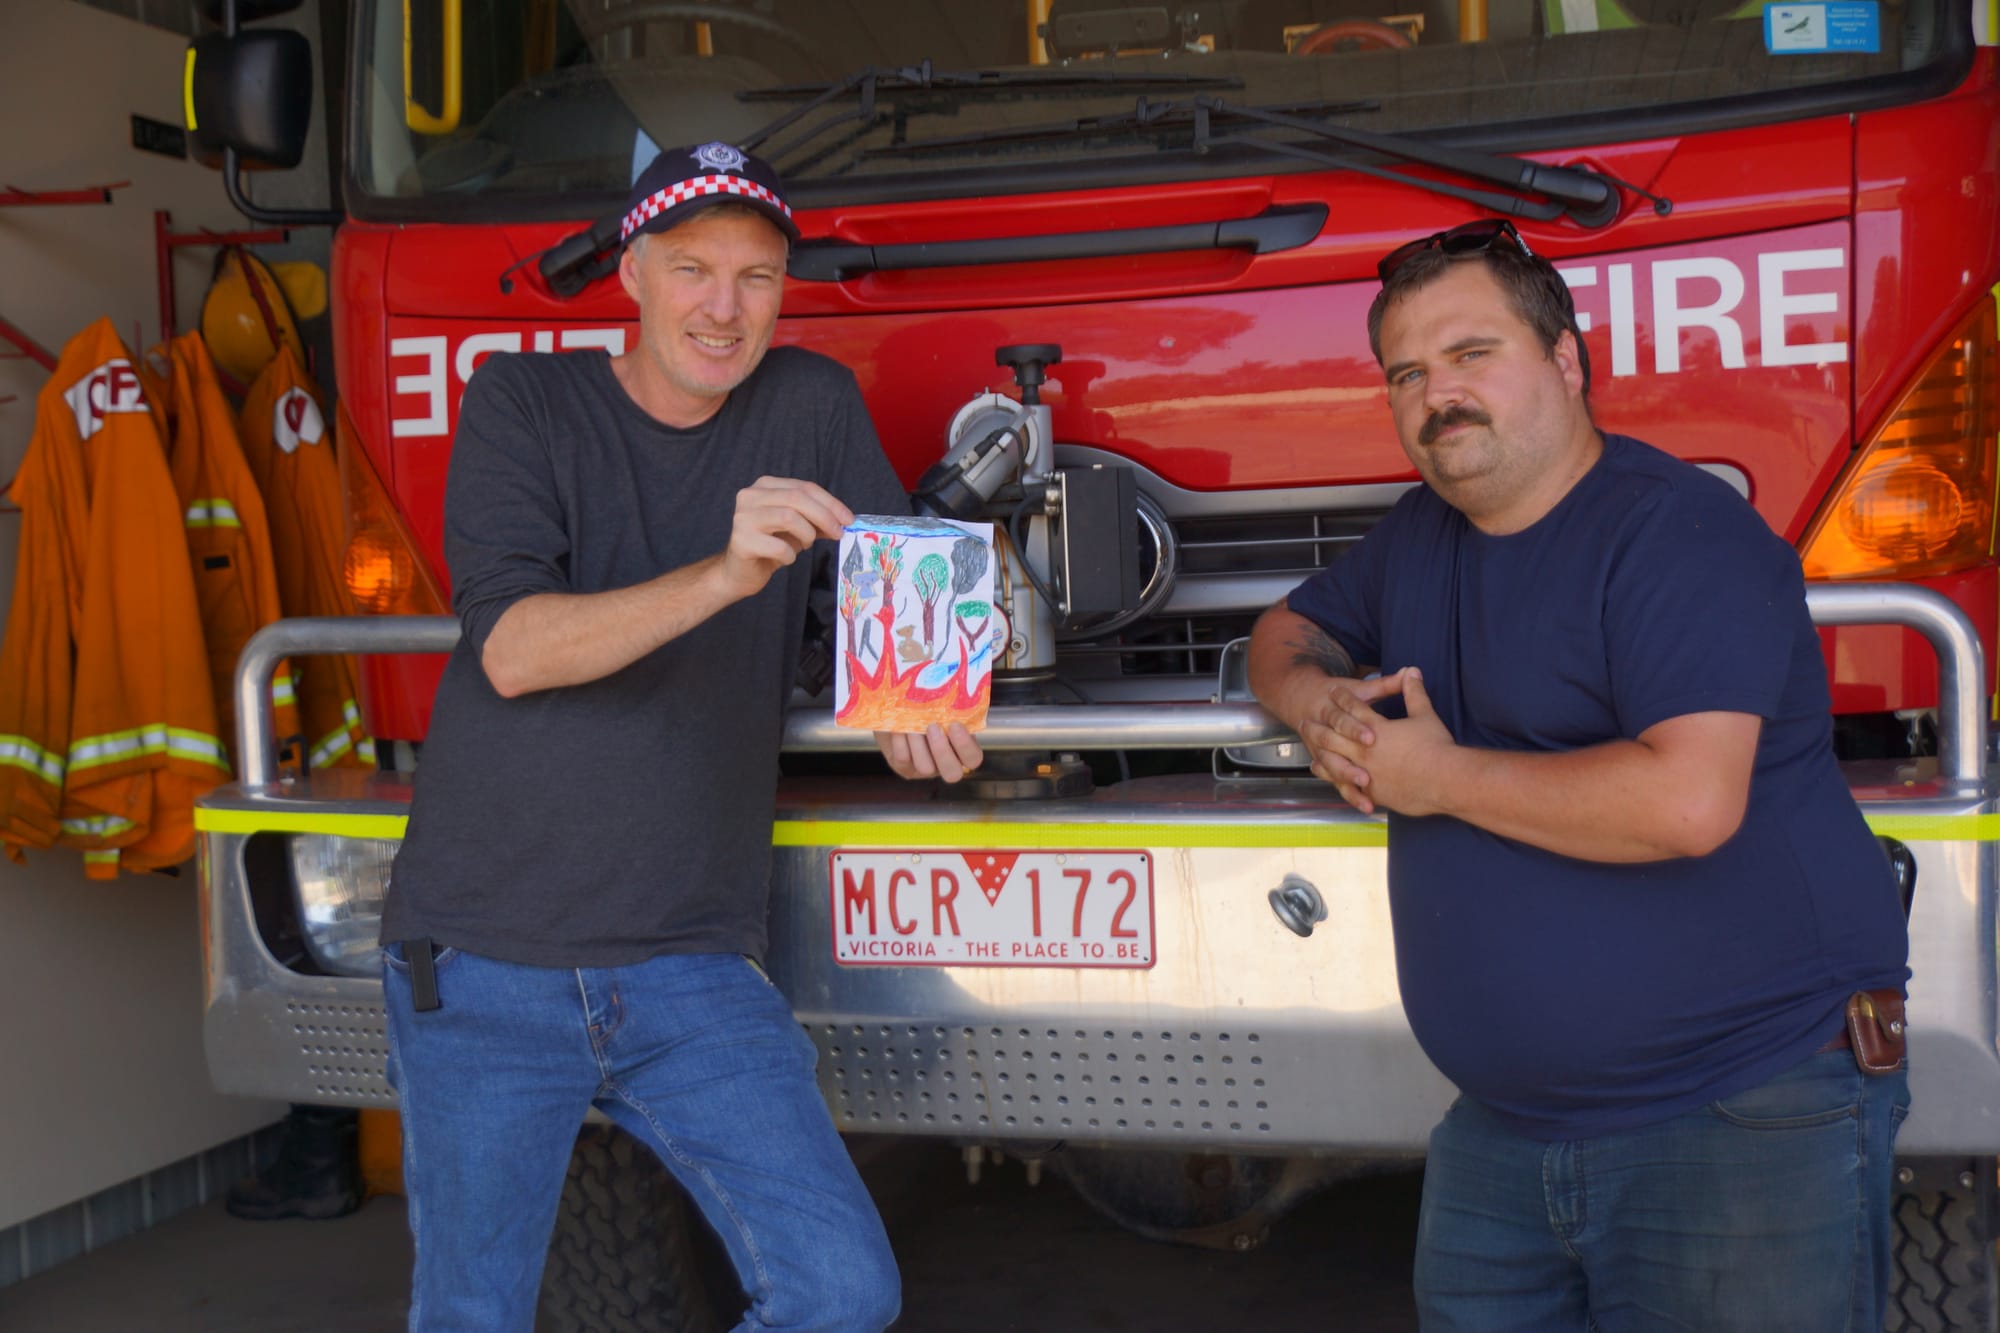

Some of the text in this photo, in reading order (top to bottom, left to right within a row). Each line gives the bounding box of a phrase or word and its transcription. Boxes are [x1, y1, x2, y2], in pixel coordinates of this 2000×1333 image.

[1558, 247, 1848, 377] IRE
[88, 366, 148, 419] CF
[842, 868, 1139, 938] MCR 172
[849, 941, 936, 957] VICTORIA
[965, 942, 1000, 957] THE
[1012, 942, 1068, 958] PLACE
[1080, 942, 1104, 958] TO
[1116, 943, 1139, 958] BE
